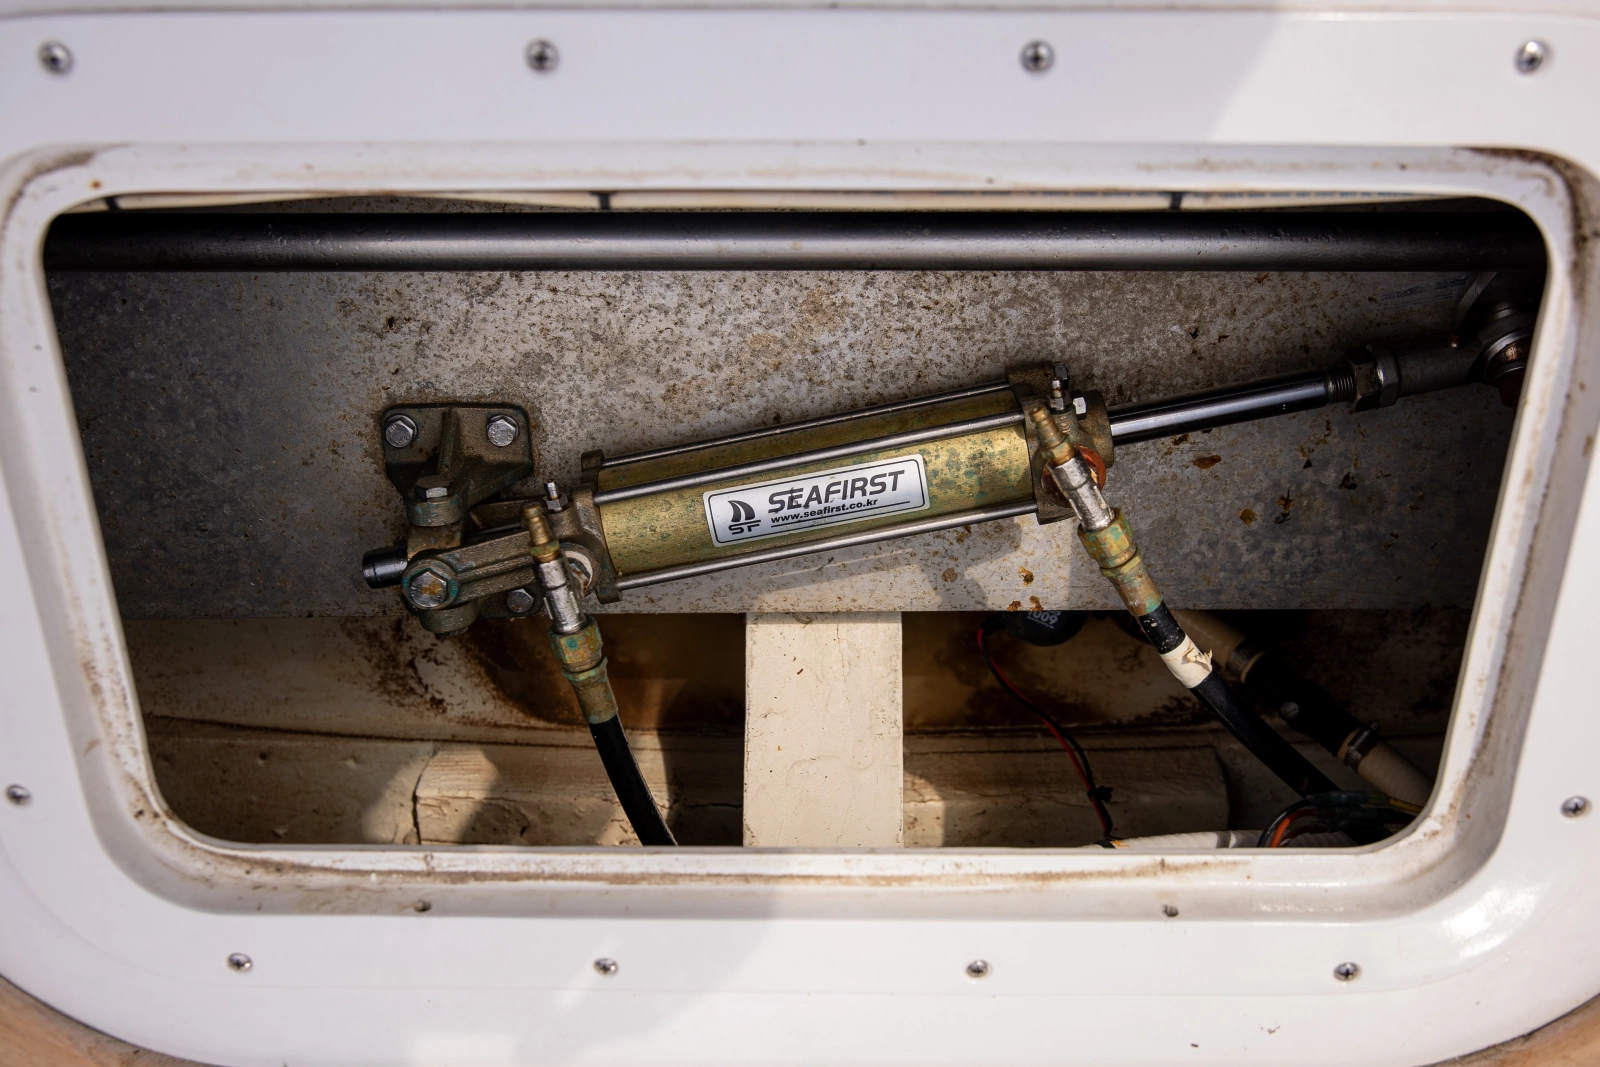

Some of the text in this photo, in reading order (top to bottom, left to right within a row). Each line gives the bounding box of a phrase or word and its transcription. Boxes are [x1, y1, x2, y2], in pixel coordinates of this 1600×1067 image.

[768, 470, 905, 514] SEAFIRST
[770, 498, 878, 524] www.seafirst.co.kr
[728, 521, 761, 535] SF
